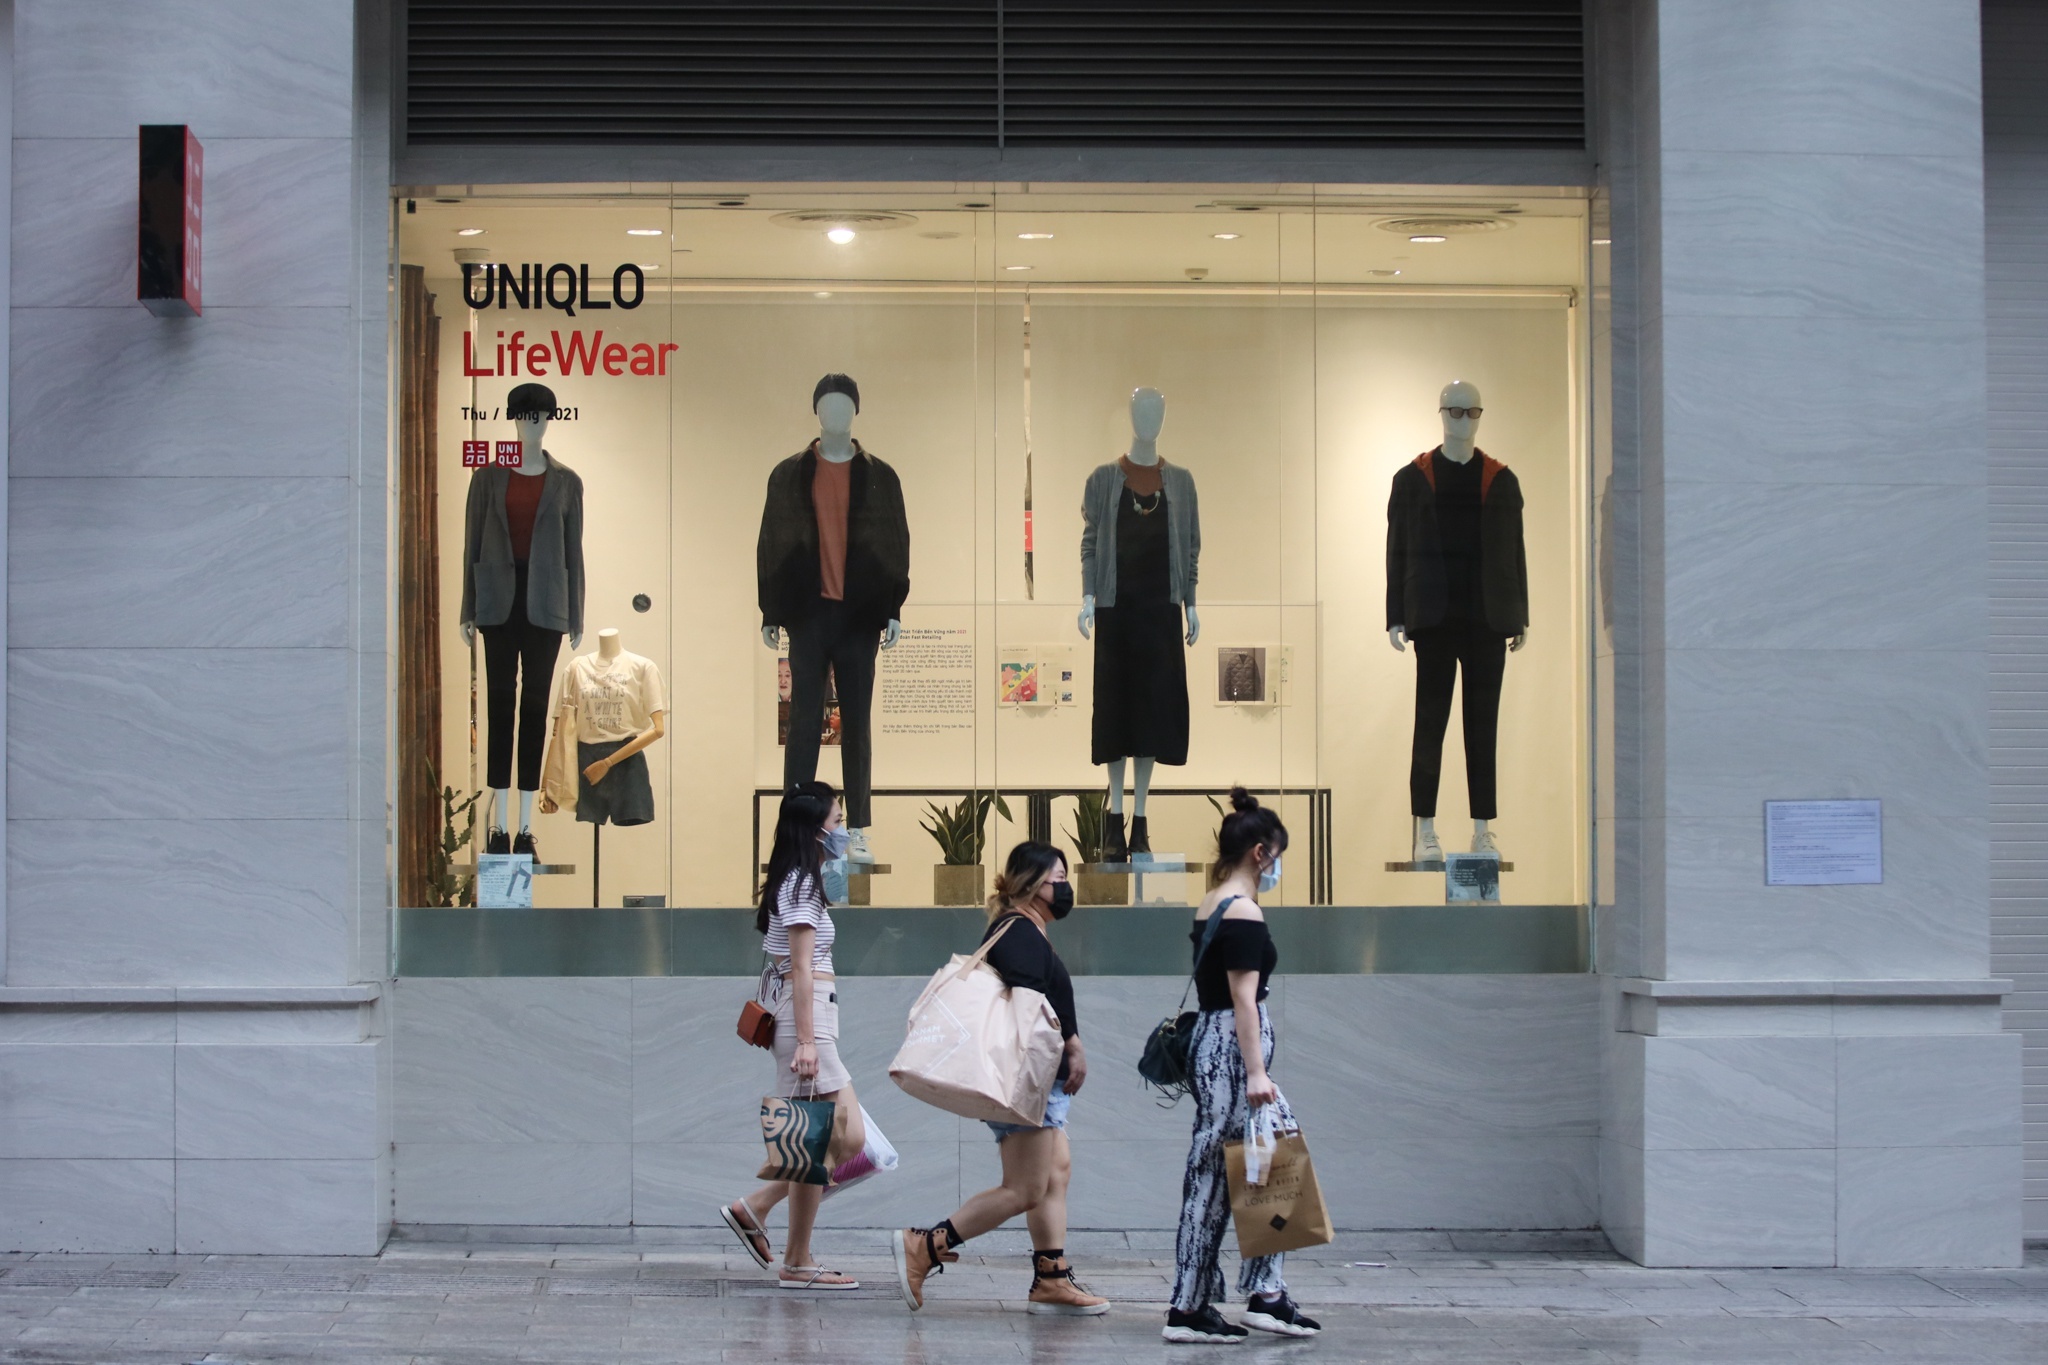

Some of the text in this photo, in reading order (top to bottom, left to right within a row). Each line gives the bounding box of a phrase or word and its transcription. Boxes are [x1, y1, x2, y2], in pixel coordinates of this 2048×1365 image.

[463, 263, 644, 317] UNIQLO
[463, 330, 679, 376] LifeWear
[461, 407, 486, 420] Thu
[546, 407, 578, 420] 2021
[498, 444, 518, 454] UNI
[498, 455, 520, 466] QLO
[1245, 1190, 1304, 1207] LOVE MUCH
